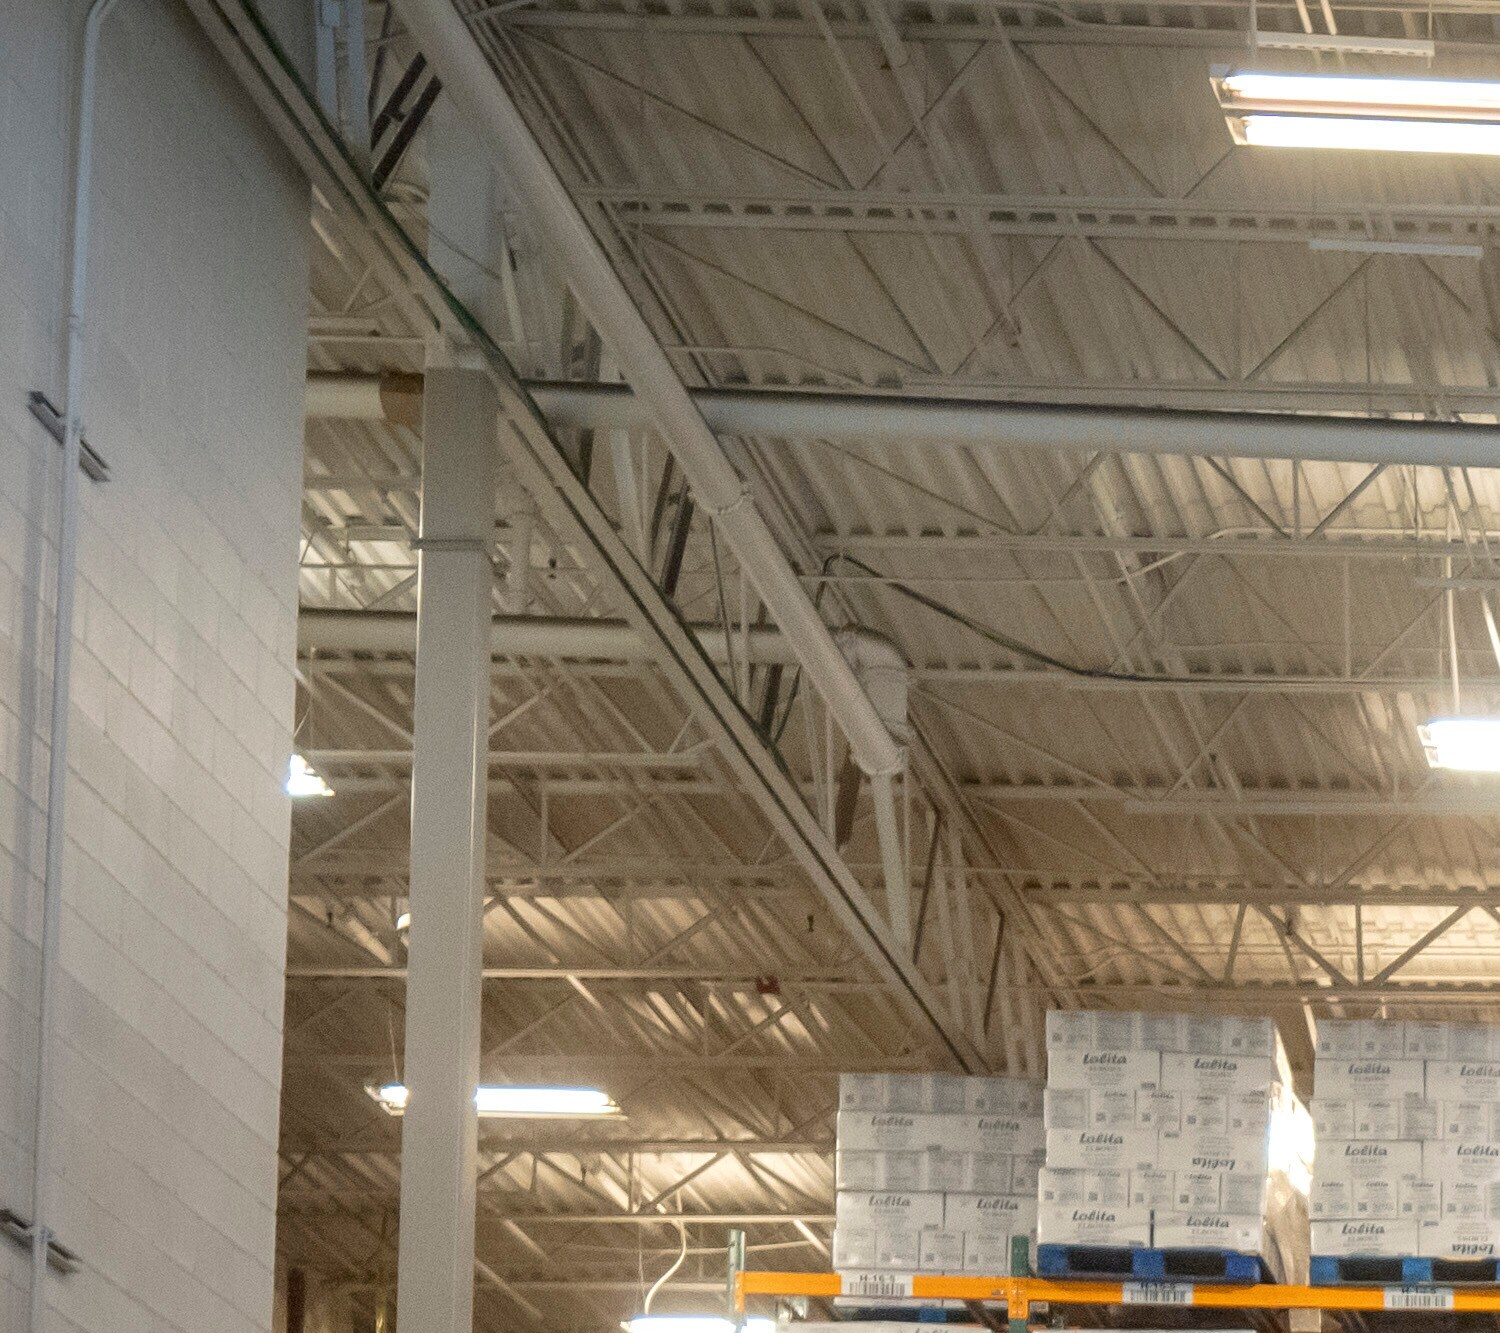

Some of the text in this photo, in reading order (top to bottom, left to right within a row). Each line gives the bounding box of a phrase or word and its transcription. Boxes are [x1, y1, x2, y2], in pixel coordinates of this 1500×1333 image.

[1083, 1052, 1127, 1067] Lolita
[1194, 1058, 1238, 1073] Lolita
[1349, 1063, 1390, 1077] Lolita
[1080, 1132, 1124, 1147] Lolita
[1344, 1144, 1388, 1159] Lolita
[1456, 1144, 1500, 1159] Lolita
[1191, 1156, 1235, 1171] Lolita
[1072, 1209, 1116, 1224] Lolita
[1342, 1223, 1383, 1237] Lolita
